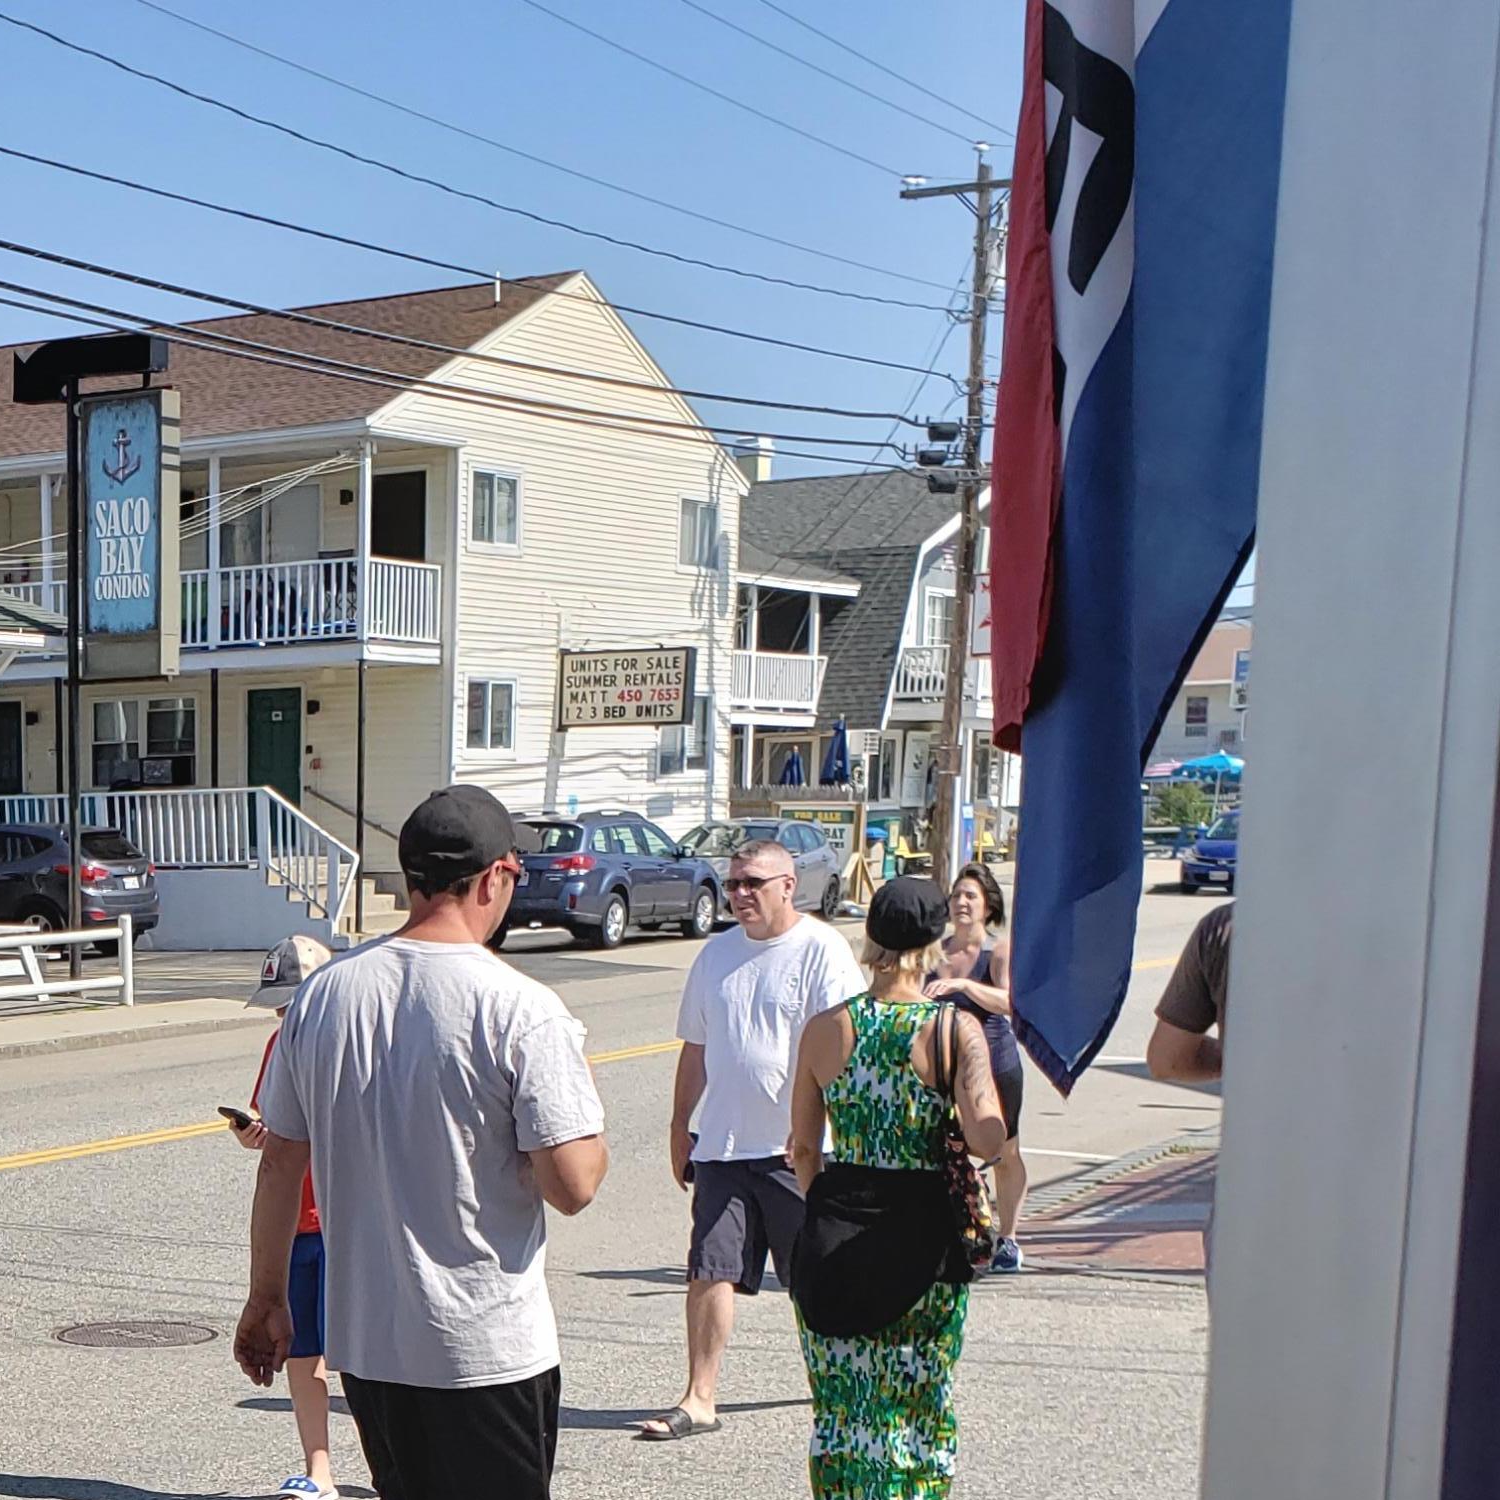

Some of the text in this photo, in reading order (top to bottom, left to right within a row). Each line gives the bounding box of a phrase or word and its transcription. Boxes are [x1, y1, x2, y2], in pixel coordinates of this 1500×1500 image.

[95, 497, 150, 538] SACO
[100, 536, 144, 575] BAY
[94, 573, 150, 600] CONDOS
[571, 656, 680, 673] UNITS FOR SALE
[566, 672, 682, 688] SUMMER RENTALS
[570, 688, 680, 704] MATT 450 7653
[576, 707, 583, 719] 2
[590, 707, 597, 719] 3
[604, 705, 626, 719] BED
[636, 704, 674, 717] UNITS
